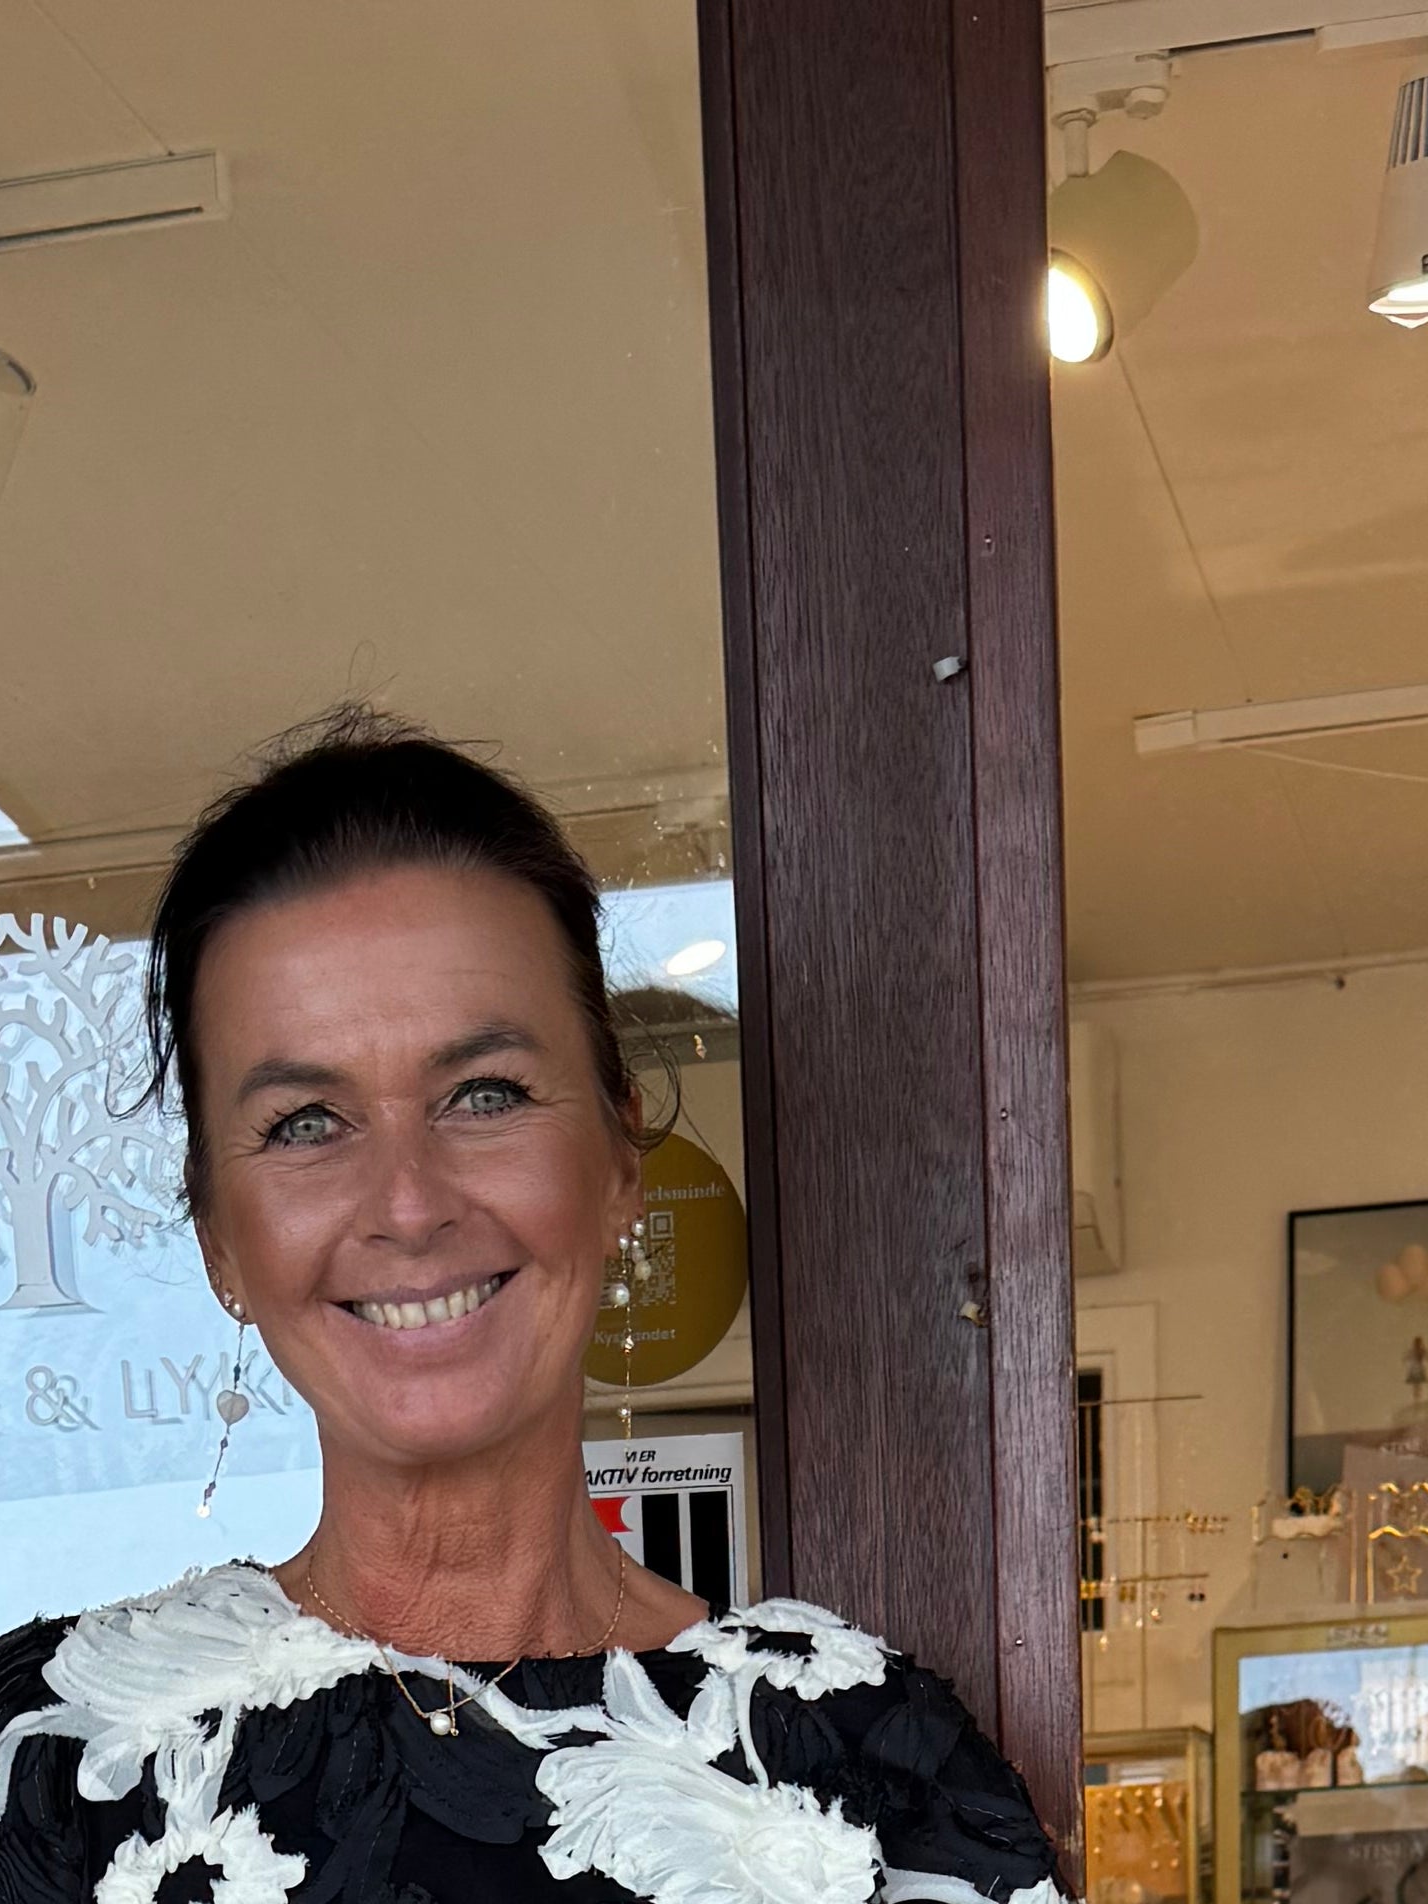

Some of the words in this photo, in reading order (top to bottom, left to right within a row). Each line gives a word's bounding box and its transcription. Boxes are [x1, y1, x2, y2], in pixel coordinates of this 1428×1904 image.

[25, 1365, 76, 1426] &
[625, 1450, 636, 1462] VI
[639, 1450, 656, 1462] ER
[641, 1464, 732, 1484] forretning
